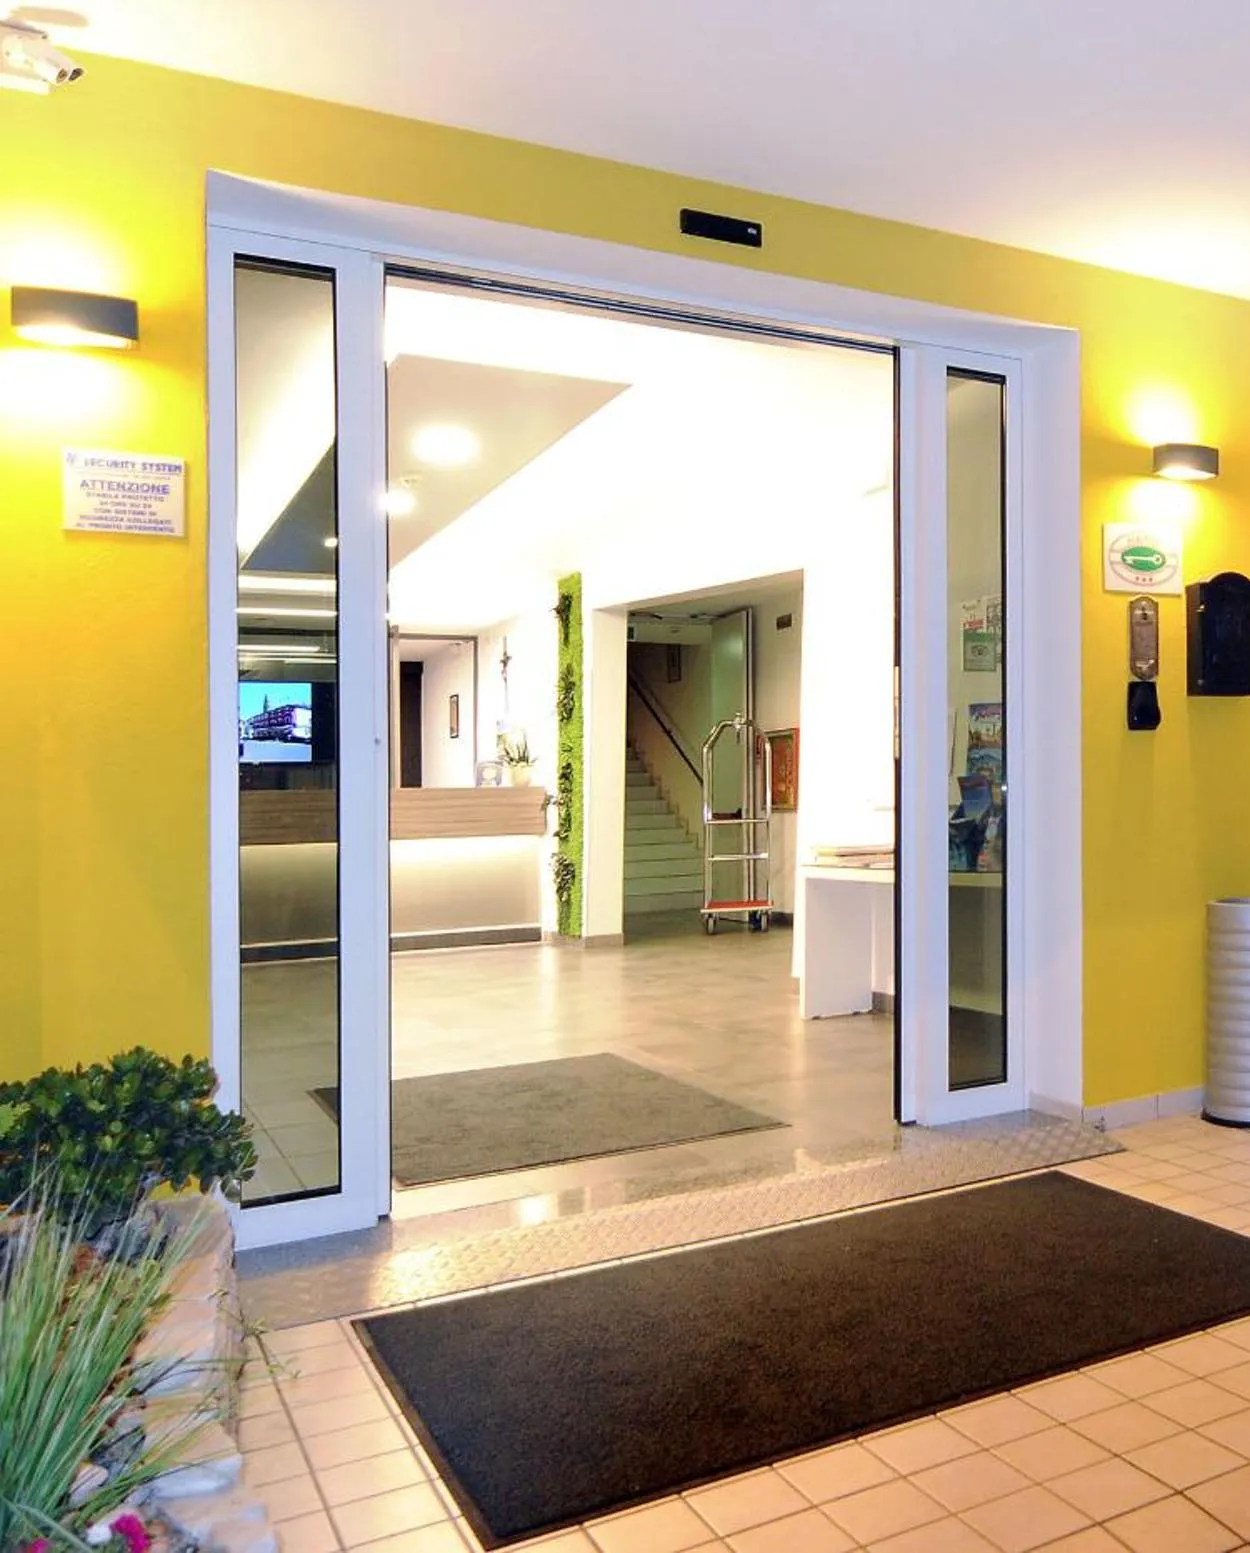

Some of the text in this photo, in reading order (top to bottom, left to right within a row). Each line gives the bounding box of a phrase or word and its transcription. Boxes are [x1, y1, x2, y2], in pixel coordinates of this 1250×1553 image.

[84, 457, 182, 473] SECURITY SYSTEM
[80, 479, 170, 496] ATTENZIONE
